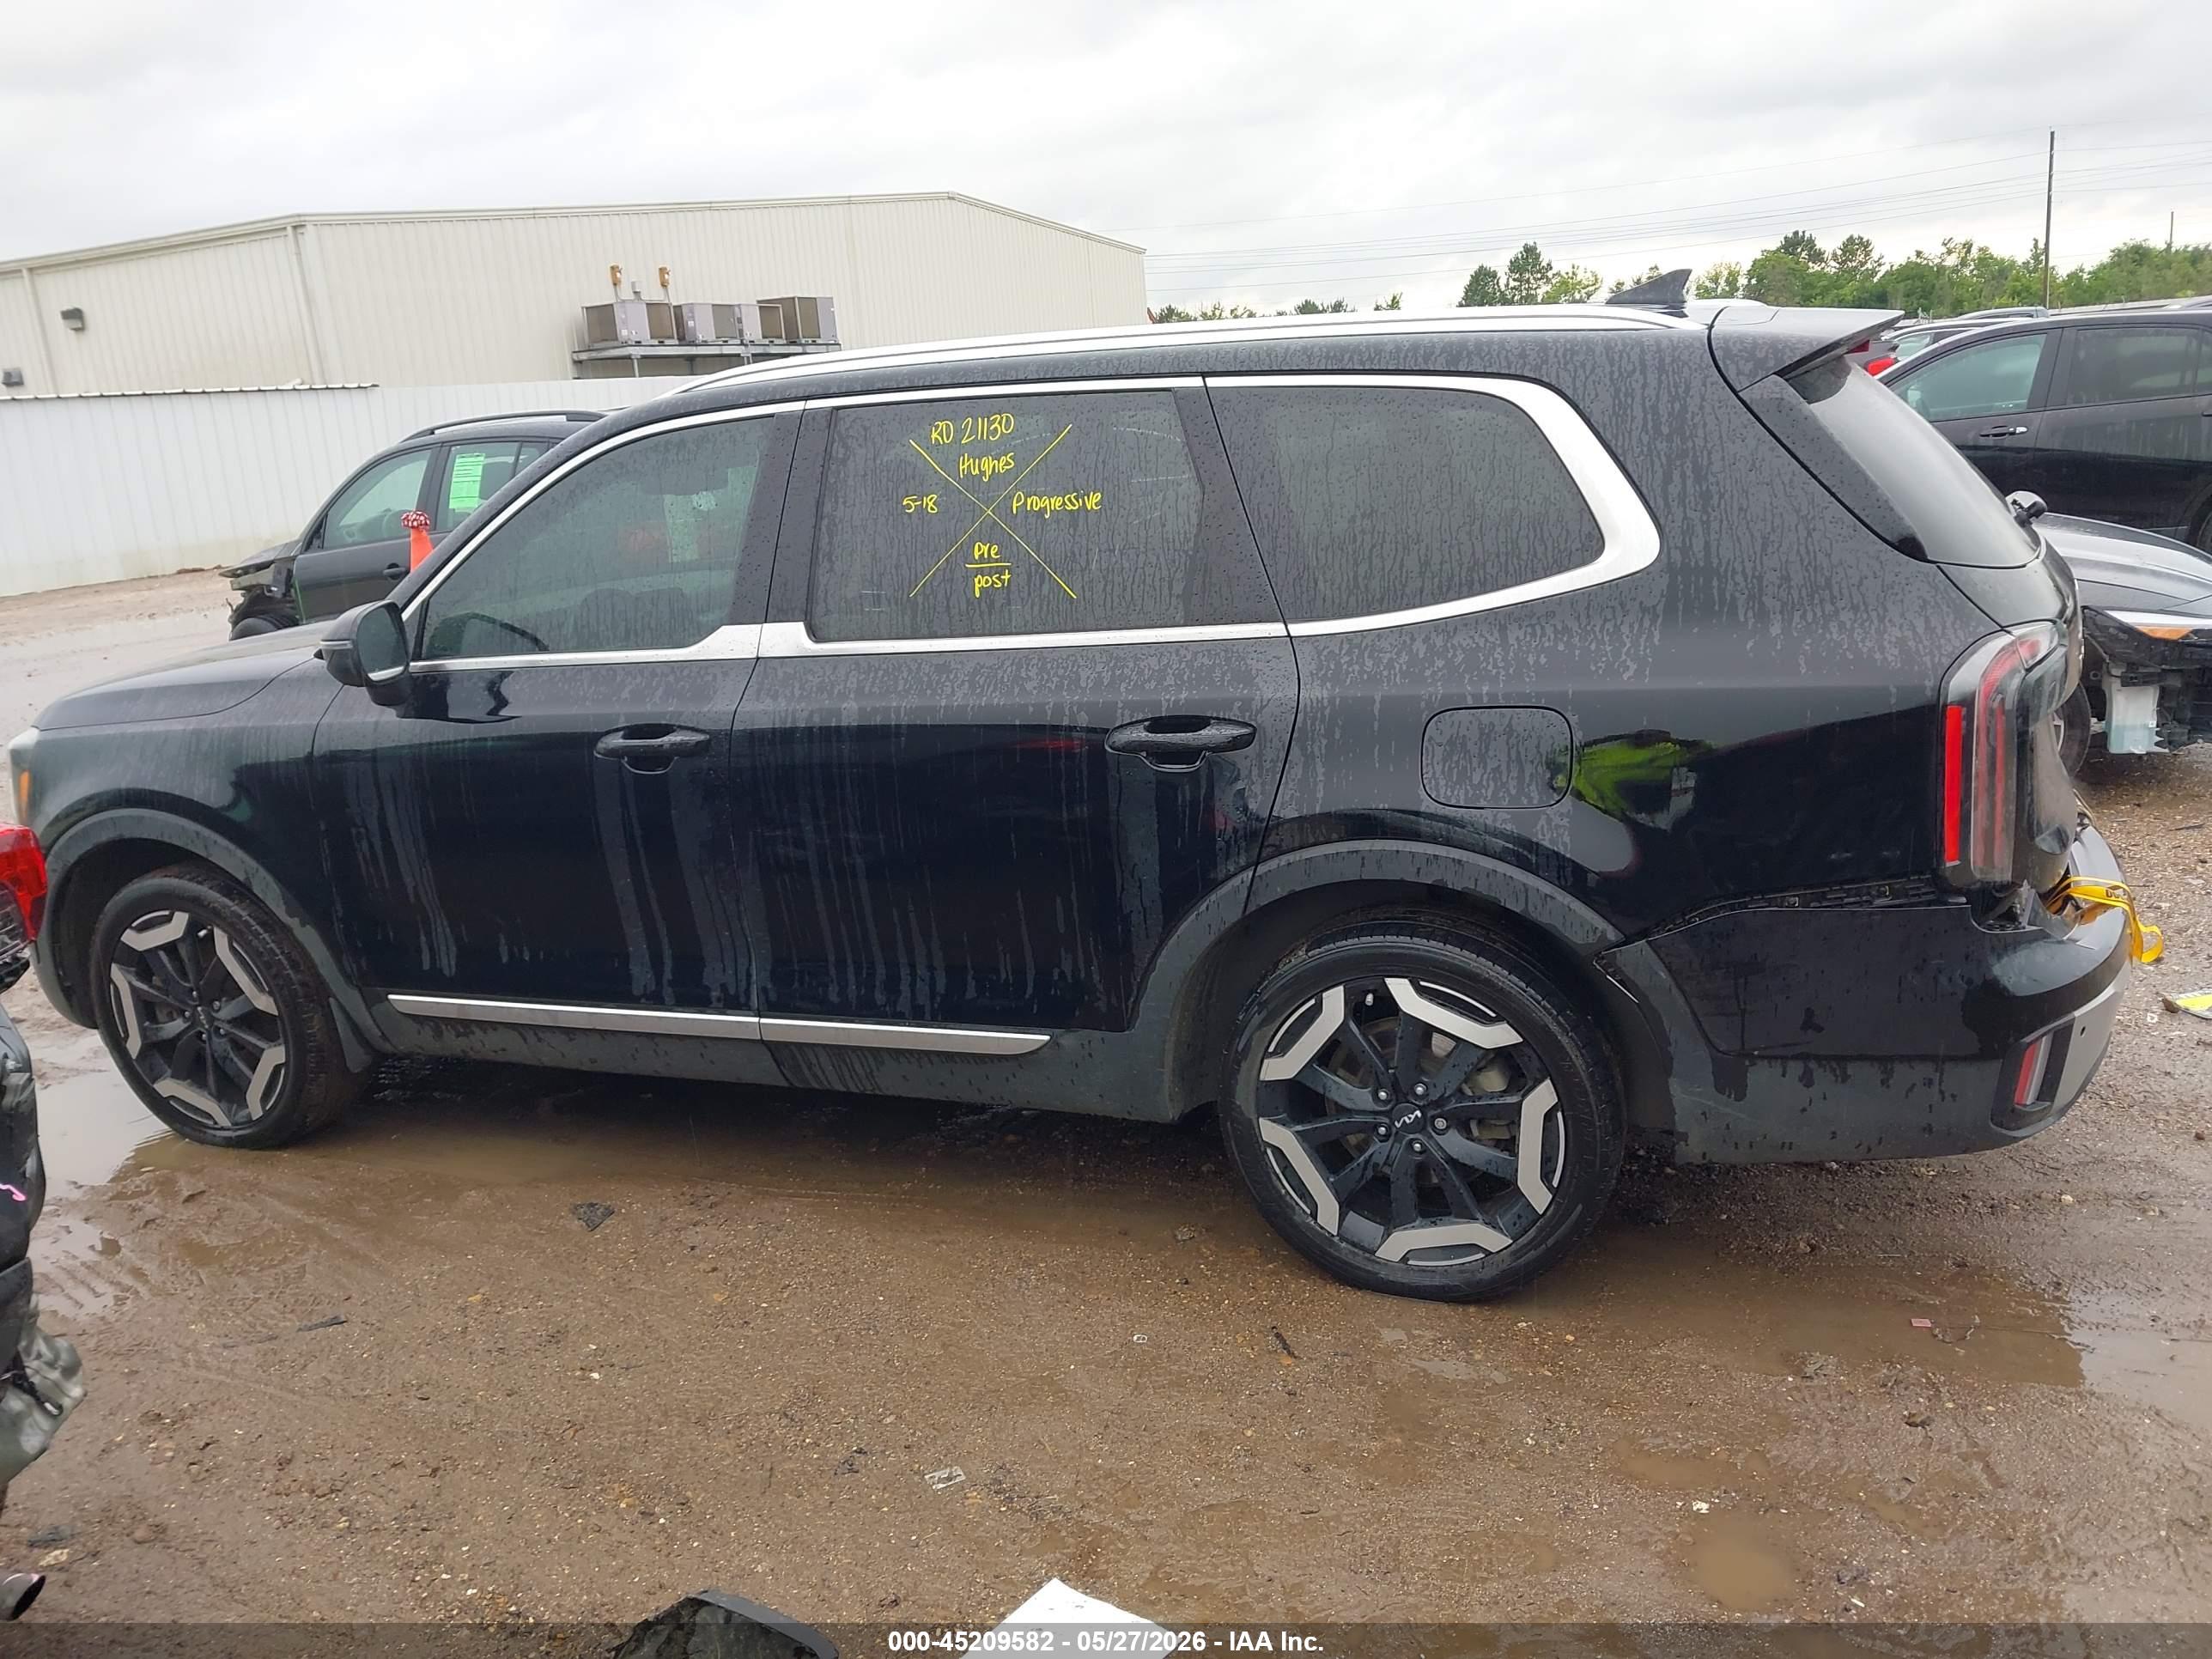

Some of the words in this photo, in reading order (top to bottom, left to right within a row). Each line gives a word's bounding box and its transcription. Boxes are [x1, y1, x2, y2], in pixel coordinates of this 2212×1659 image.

[961, 413, 1015, 444] 21130
[958, 452, 1015, 482] Hughes
[902, 494, 939, 514] 5-18
[1012, 490, 1103, 519] Progressive
[973, 568, 1012, 599] post
